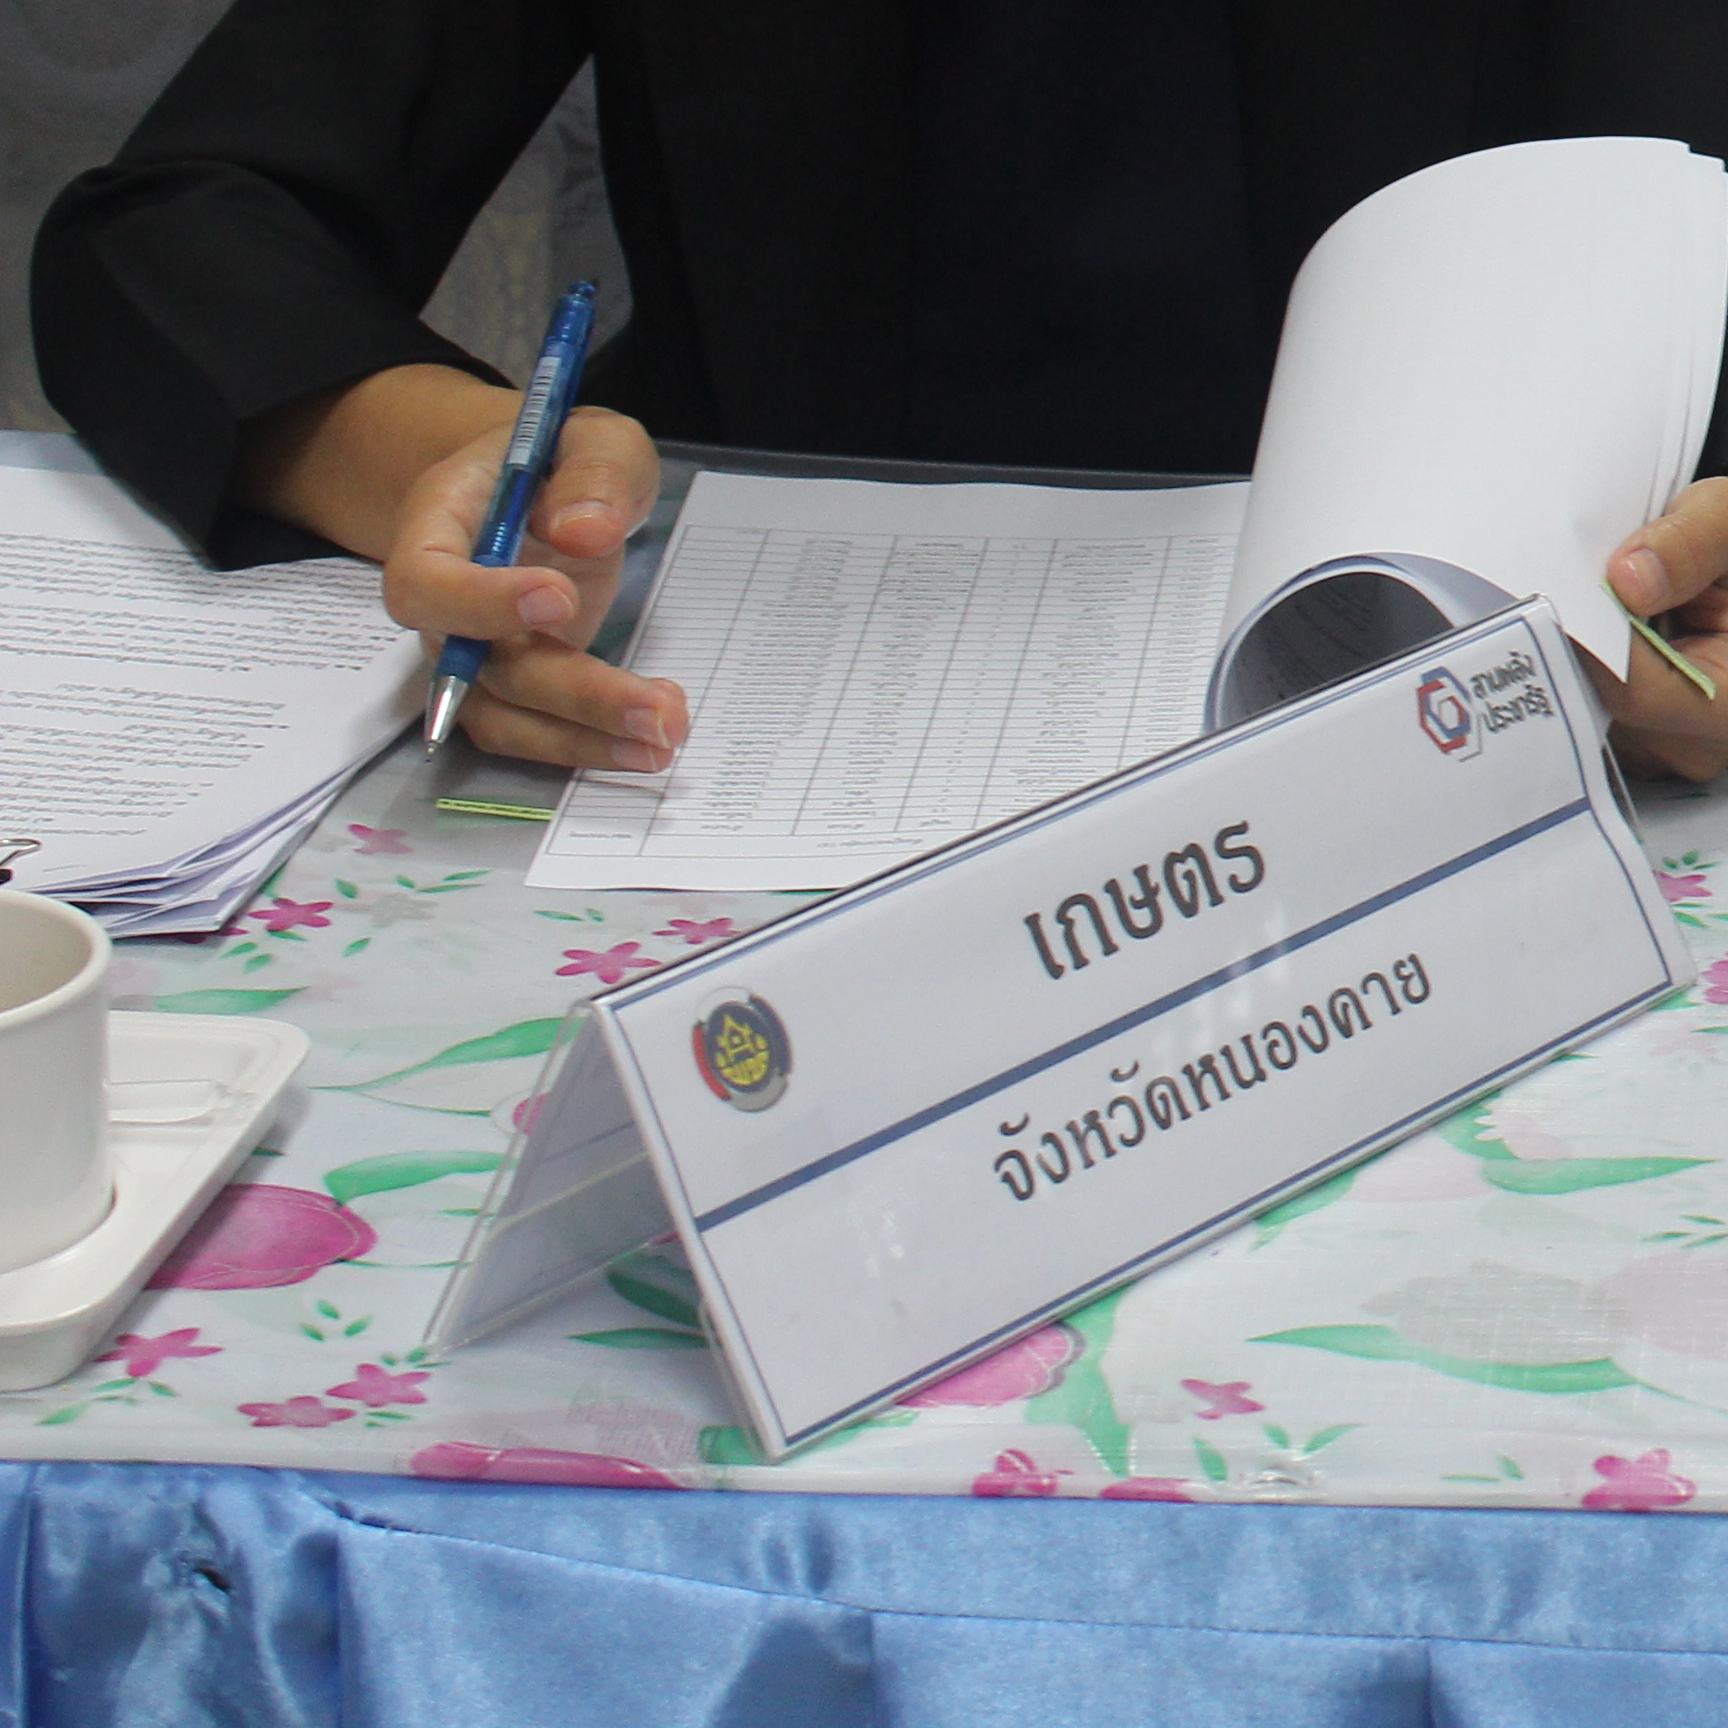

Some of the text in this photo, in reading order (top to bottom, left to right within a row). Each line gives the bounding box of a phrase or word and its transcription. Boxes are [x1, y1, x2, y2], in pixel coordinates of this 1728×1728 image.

[1021, 819, 1267, 982] เกษตร
[993, 950, 1433, 1204] จังหวัดหนองคาย
